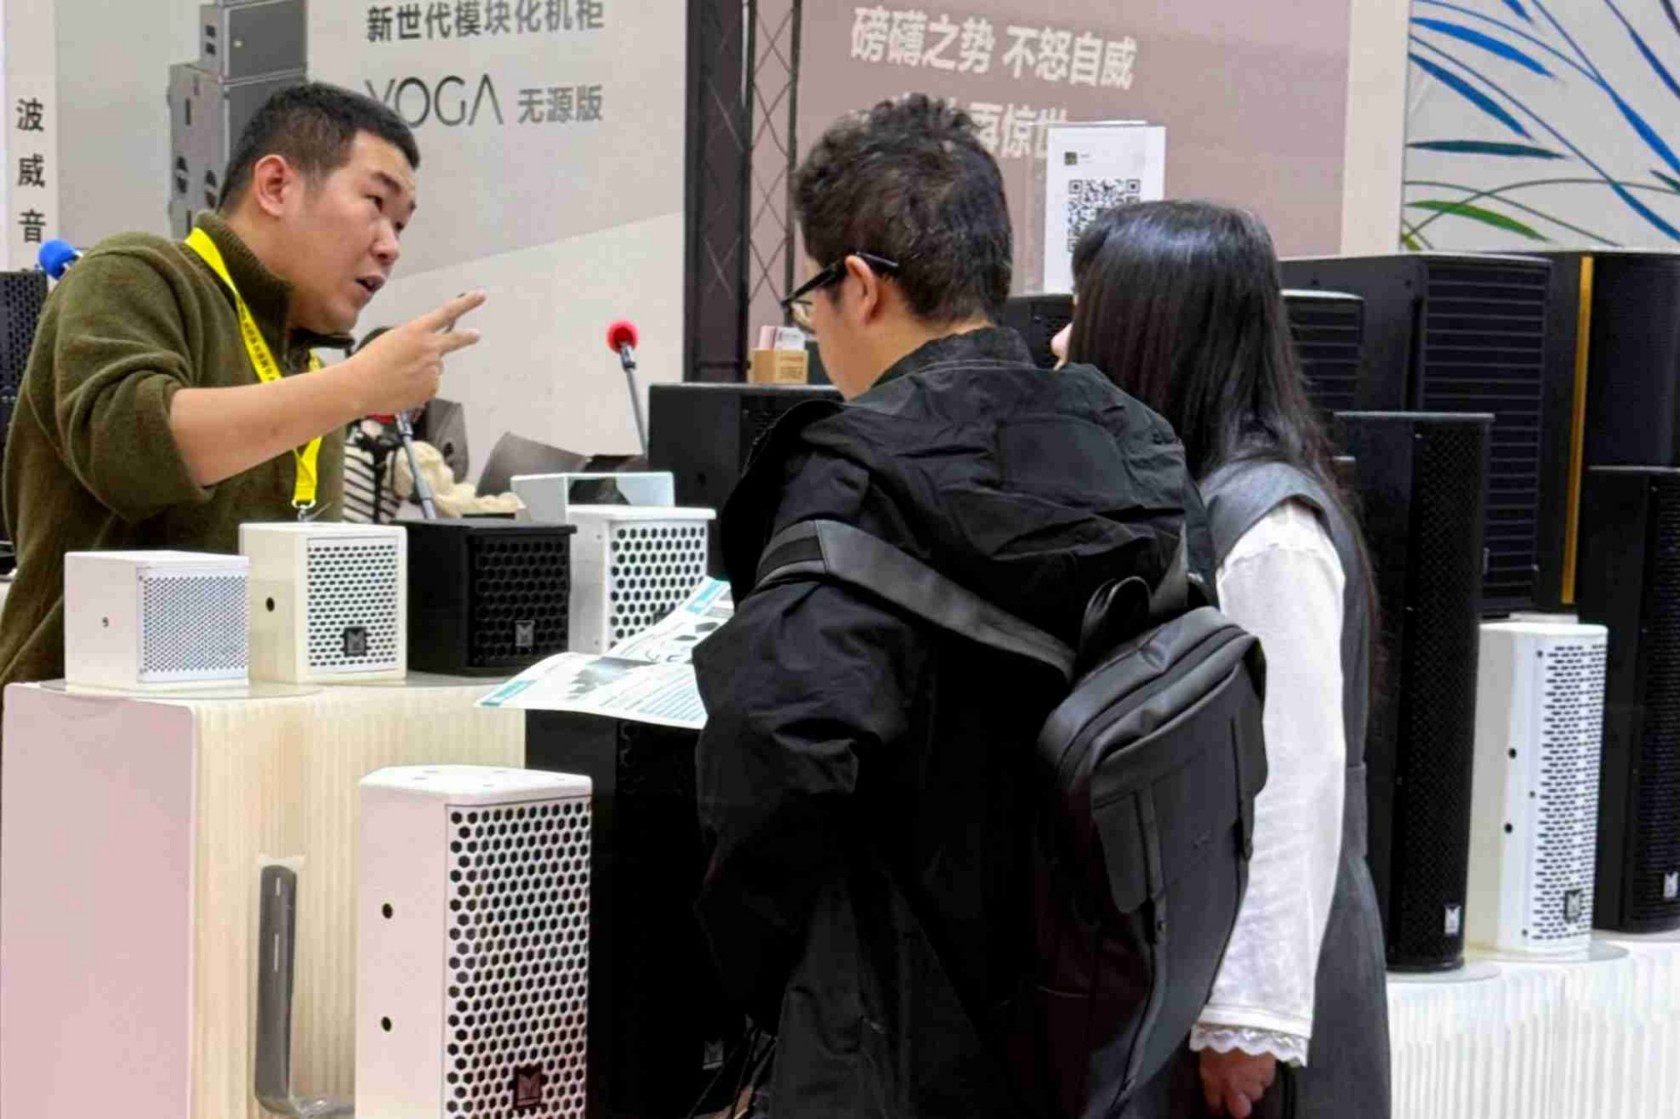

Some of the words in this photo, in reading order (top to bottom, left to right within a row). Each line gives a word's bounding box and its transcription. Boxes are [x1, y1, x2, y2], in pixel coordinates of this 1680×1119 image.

[367, 0, 604, 42] 新世代模块化机柜
[850, 6, 996, 73] 磅礴之势
[1002, 25, 1138, 90] 不怒自威
[518, 85, 603, 124] 无源版
